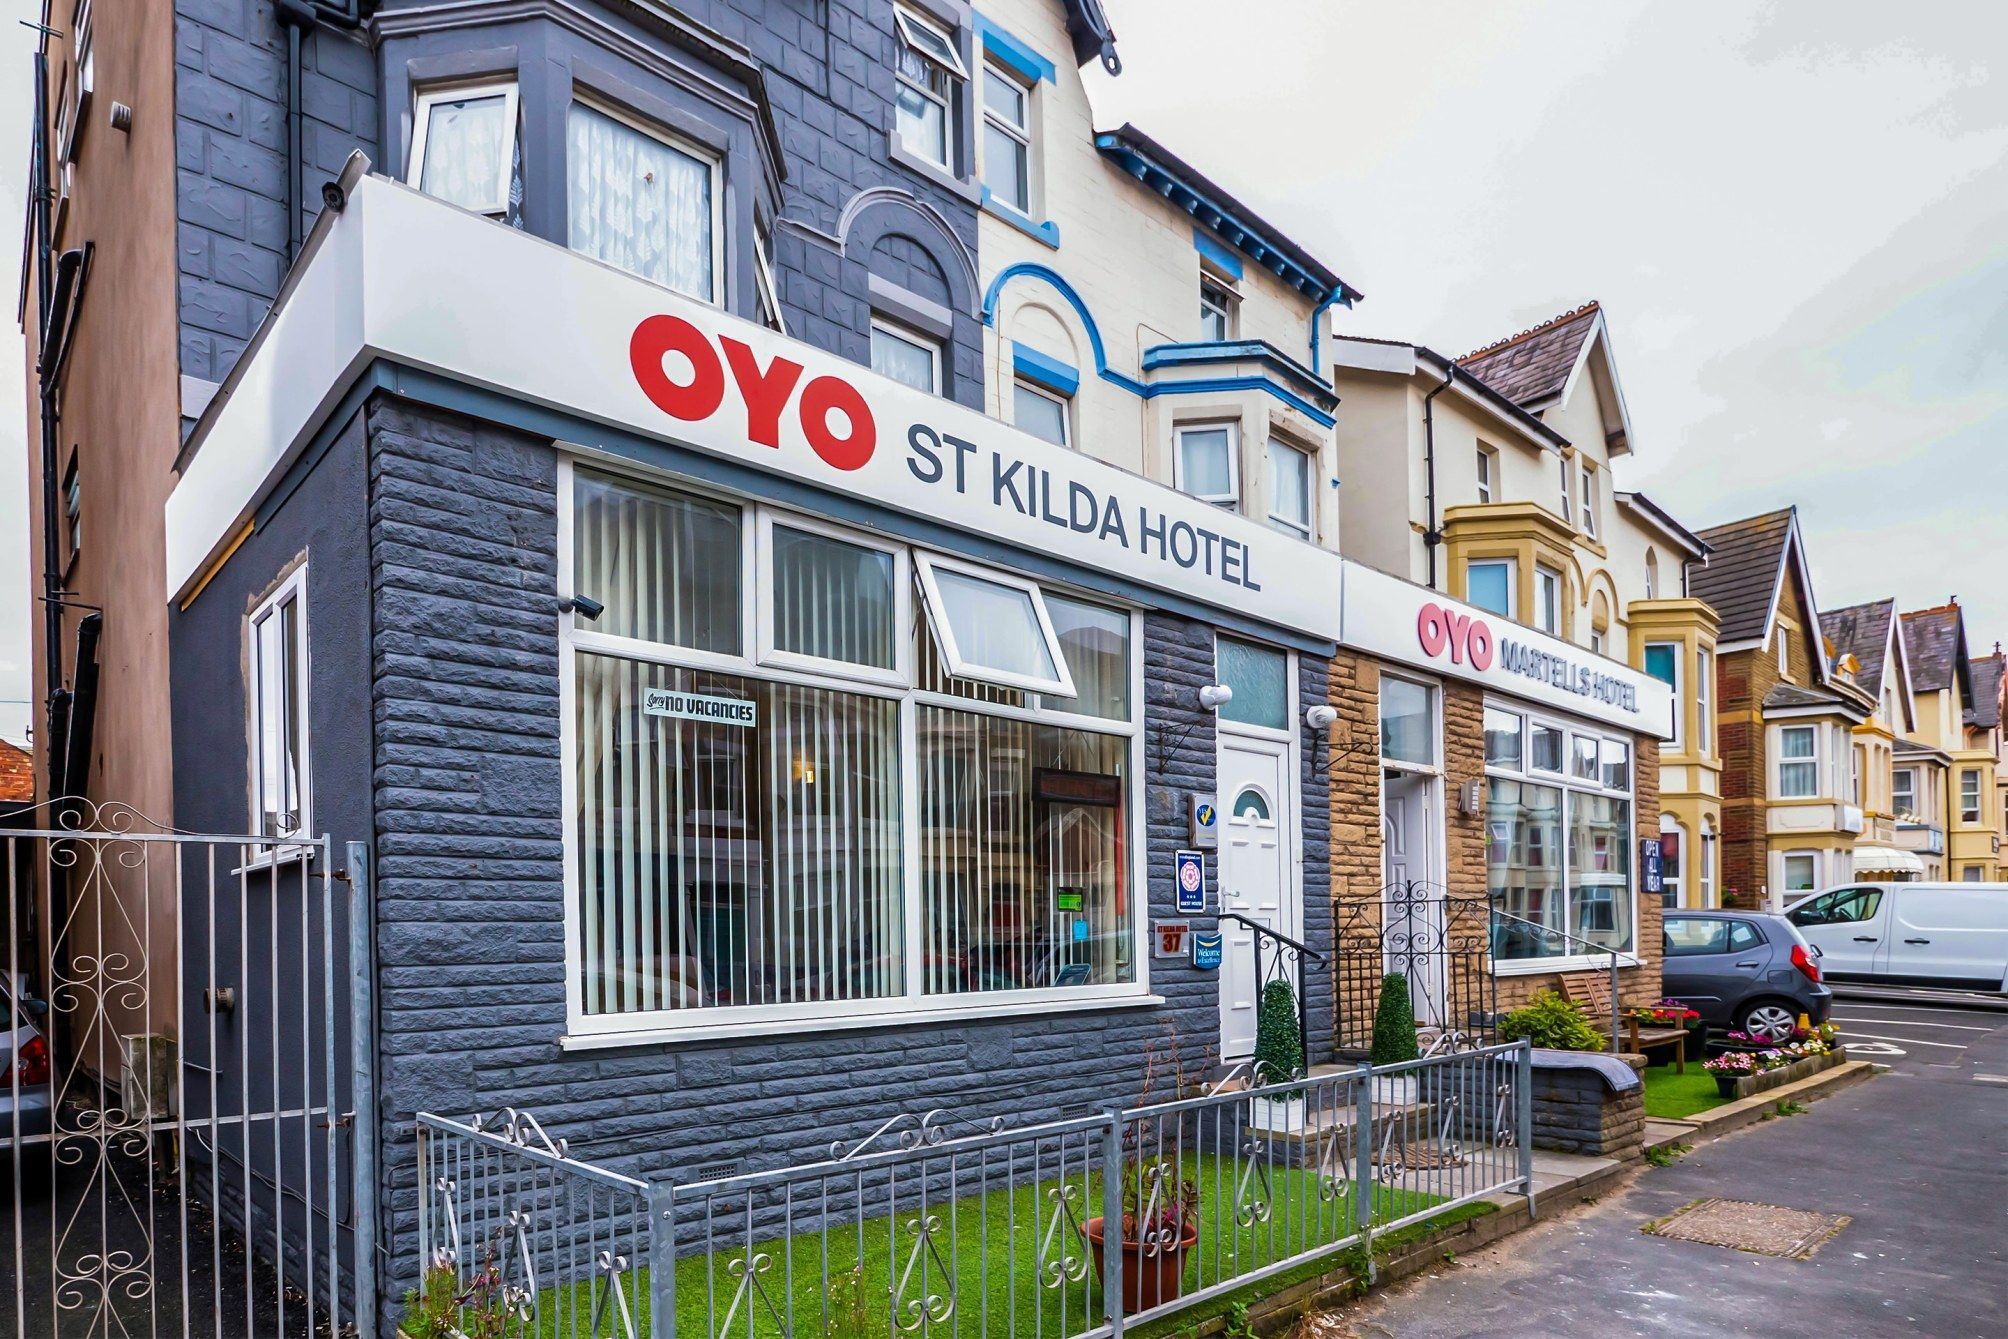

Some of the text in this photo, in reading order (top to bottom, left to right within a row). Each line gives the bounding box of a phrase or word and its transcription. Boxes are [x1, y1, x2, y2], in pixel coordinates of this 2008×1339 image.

[630, 314, 1261, 592] OYO ST KILDA HOTEL
[1418, 603, 1640, 713] OYO MARTELLS HOTEL
[647, 693, 753, 721] Sorry NO VACANCIES
[1645, 840, 1659, 857] OPEN
[1163, 933, 1181, 953] 37
[1197, 948, 1221, 957] Welcome
